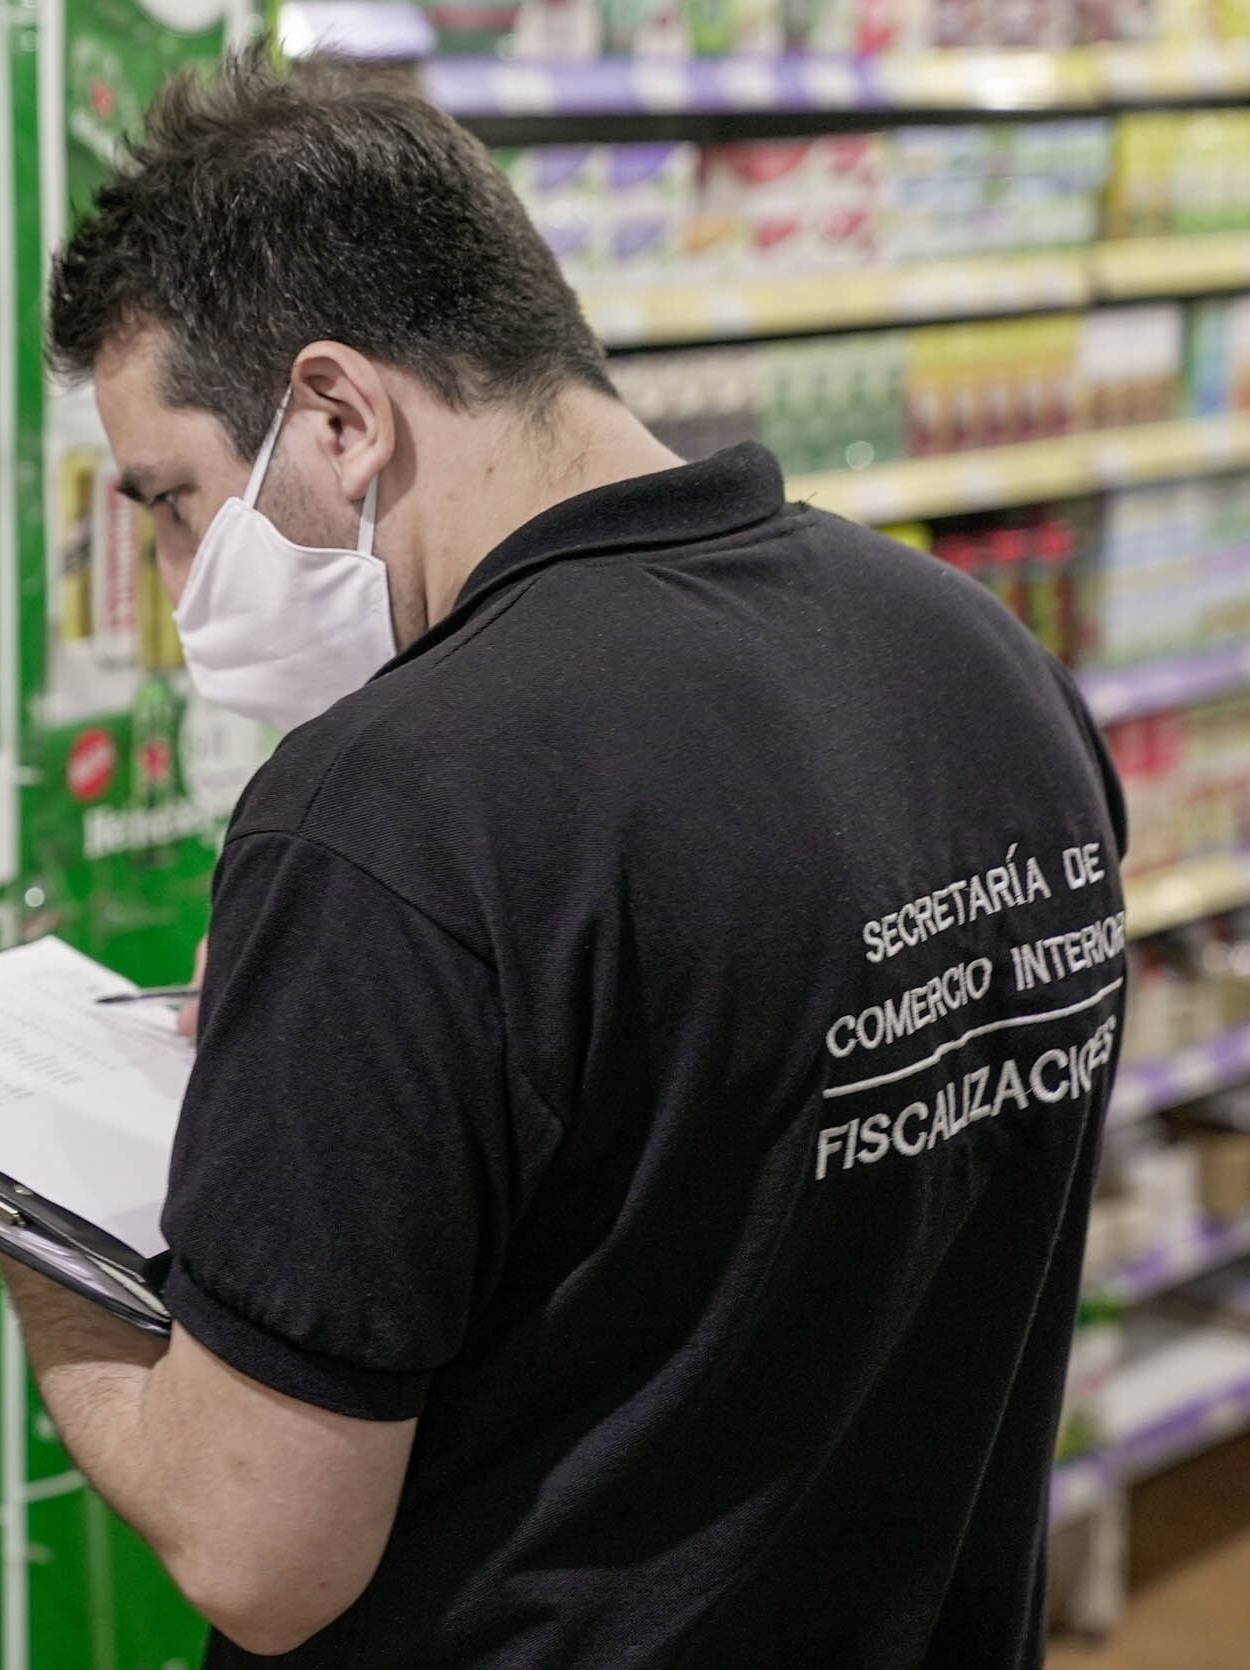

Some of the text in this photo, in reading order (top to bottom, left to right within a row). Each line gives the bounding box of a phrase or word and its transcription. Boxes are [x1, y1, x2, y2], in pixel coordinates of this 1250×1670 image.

[862, 842, 1106, 963] SECRETARÍA DE
[825, 956, 994, 1059] COMERCIO
[814, 1014, 1117, 1181] FISCALIZACIOES
